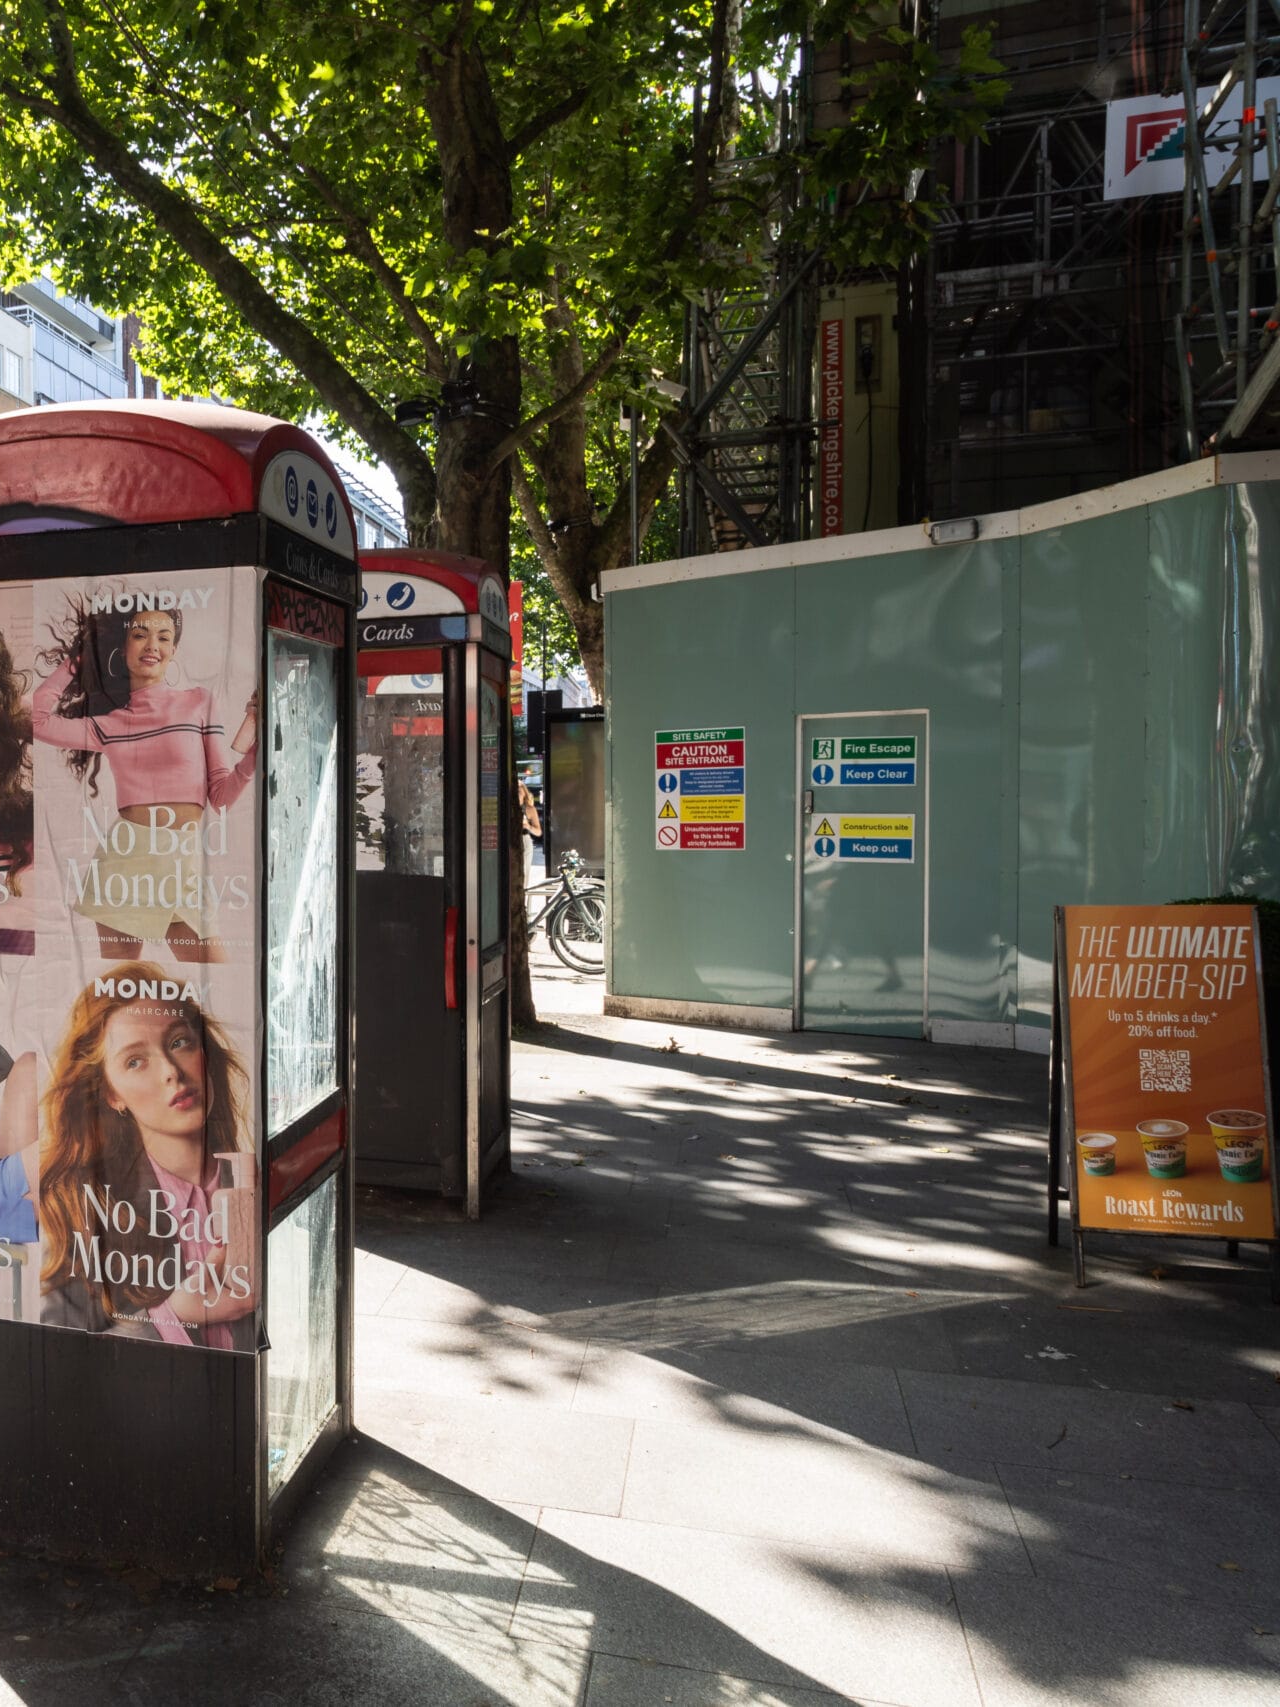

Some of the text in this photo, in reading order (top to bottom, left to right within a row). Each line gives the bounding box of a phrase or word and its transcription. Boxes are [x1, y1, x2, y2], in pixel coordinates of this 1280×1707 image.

[824, 321, 841, 537] www.pickeringshire.co.
[286, 542, 307, 576] Coins
[317, 558, 338, 587] Cards
[91, 587, 215, 615] MONDAY
[123, 618, 182, 629] HAIRCARE
[363, 623, 415, 642] Cards
[672, 731, 727, 741] SITE SAFETY
[672, 745, 727, 757] CAUTION
[845, 743, 911, 755] Fire Escape
[665, 755, 735, 766] SITE ENTRANCE
[846, 769, 908, 780] Keep Clear
[82, 804, 229, 856] No Bad
[852, 844, 899, 854] Keep out
[64, 857, 250, 922] Mondays
[1078, 926, 1251, 959] THE ULTIMATE
[1070, 963, 1247, 1000] MEMBER-SIP
[94, 977, 210, 1004] MONDAY
[125, 1007, 185, 1018] HAIRCARE
[1108, 1010, 1121, 1023] Up
[1124, 1012, 1133, 1021] to
[1136, 1011, 1144, 1021] 5
[1146, 1011, 1179, 1023] drinks
[1183, 1014, 1189, 1023] a
[1128, 1025, 1199, 1038] 20% off food.
[1224, 1140, 1254, 1149] LEON
[1162, 1189, 1183, 1198] LEON
[82, 1183, 230, 1245] No Bad
[1105, 1195, 1244, 1223] Roast Rewards
[69, 1231, 251, 1308] Mondays
[111, 1312, 199, 1329] MONDAYHAIRCARE.COM
